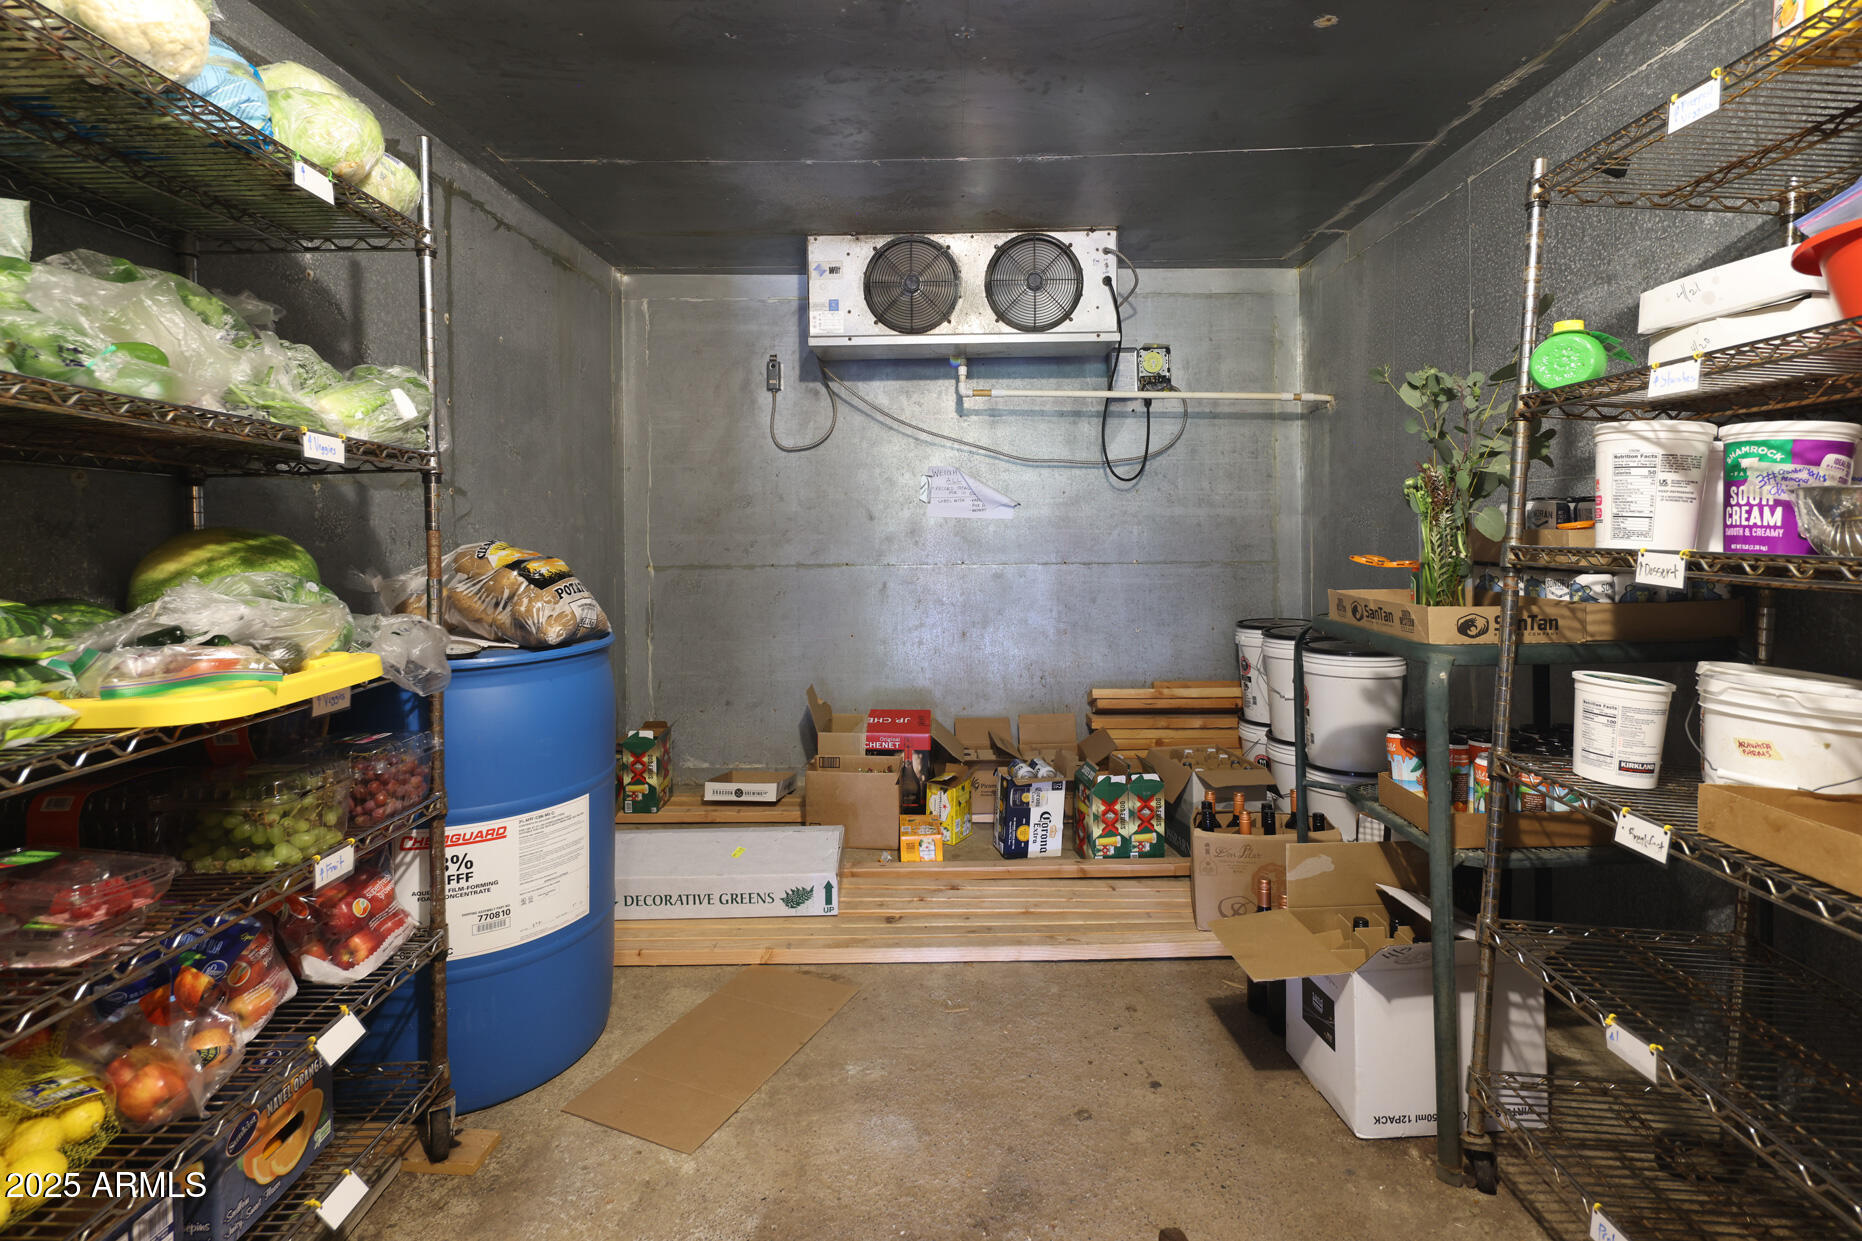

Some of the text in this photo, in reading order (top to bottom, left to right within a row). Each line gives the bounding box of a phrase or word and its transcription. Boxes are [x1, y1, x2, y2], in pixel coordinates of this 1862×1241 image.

[1676, 282, 1702, 302] 4/21
[1690, 337, 1711, 352] 4/20
[1727, 446, 1785, 464] SHAMROCK
[1726, 506, 1783, 527] CREAM
[1745, 528, 1751, 536] &
[1752, 528, 1784, 538] CREAMY
[1645, 563, 1679, 579] Dessert
[1364, 604, 1394, 624] SanTan
[1494, 614, 1559, 631] SnTan
[864, 741, 900, 749] CHENET
[1620, 761, 1656, 770] KIRKLAND
[400, 826, 507, 850] CHEGUARD
[1033, 822, 1041, 844] Extra
[1039, 811, 1053, 853] Corona
[326, 855, 345, 879] Fruit
[447, 872, 474, 885] FFF
[411, 880, 499, 897] AQUE FILM-FORMING
[445, 888, 492, 899] ONCENTRATE
[623, 892, 775, 907] DECORATIVE GREENS
[477, 908, 511, 922] 770810
[823, 906, 835, 914] UP
[266, 1057, 324, 1117] NAVEL ORANGE
[1373, 1113, 1412, 1125] 12PACK
[1415, 1113, 1438, 1123] 50ml
[228, 1115, 257, 1153] Sunkist
